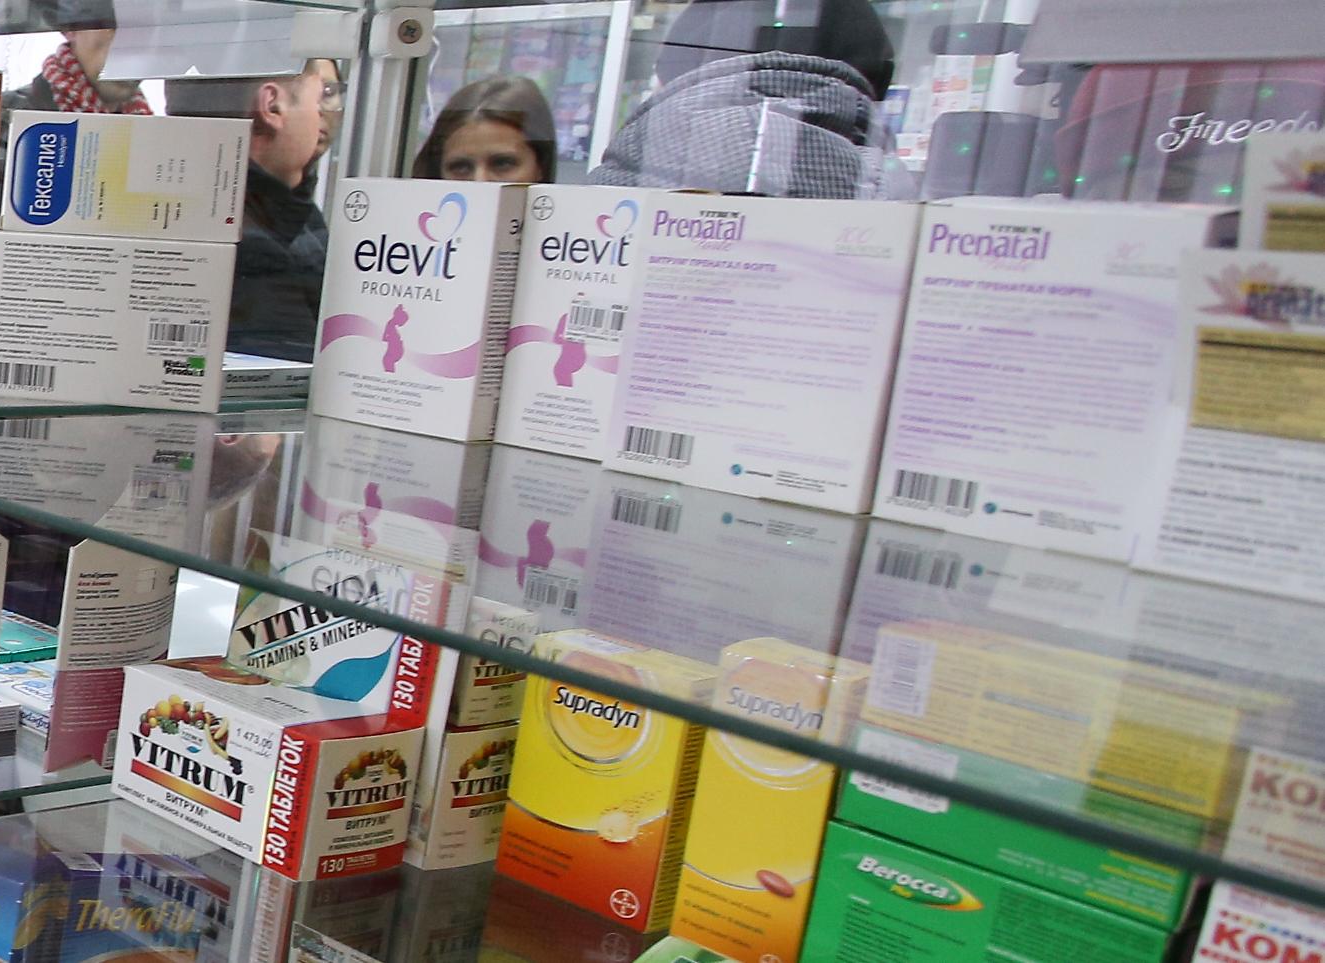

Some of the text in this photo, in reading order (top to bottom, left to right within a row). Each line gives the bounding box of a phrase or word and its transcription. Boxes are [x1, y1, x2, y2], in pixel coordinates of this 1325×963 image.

[28, 132, 58, 217] Гексализ
[652, 209, 746, 242] Prenatal
[928, 223, 1051, 261] Prenatal
[355, 234, 458, 280] elevit
[540, 231, 631, 267] elevit
[360, 280, 443, 302] PRONATAL
[546, 268, 618, 285] PRONATAL
[393, 684, 417, 710] 130
[553, 686, 640, 729] Supradyn
[729, 686, 825, 731] Supradyn
[129, 732, 248, 806] VITRUM
[269, 734, 305, 832] ТАБЛЕТОК
[165, 791, 205, 818] ВИТРУМ
[325, 780, 411, 807] VITRUM
[345, 814, 388, 830] ВИТРУМ
[265, 834, 287, 865] 130
[321, 857, 344, 873] 130
[857, 855, 950, 899] Berocca
[75, 899, 197, 934] TheraFlu
